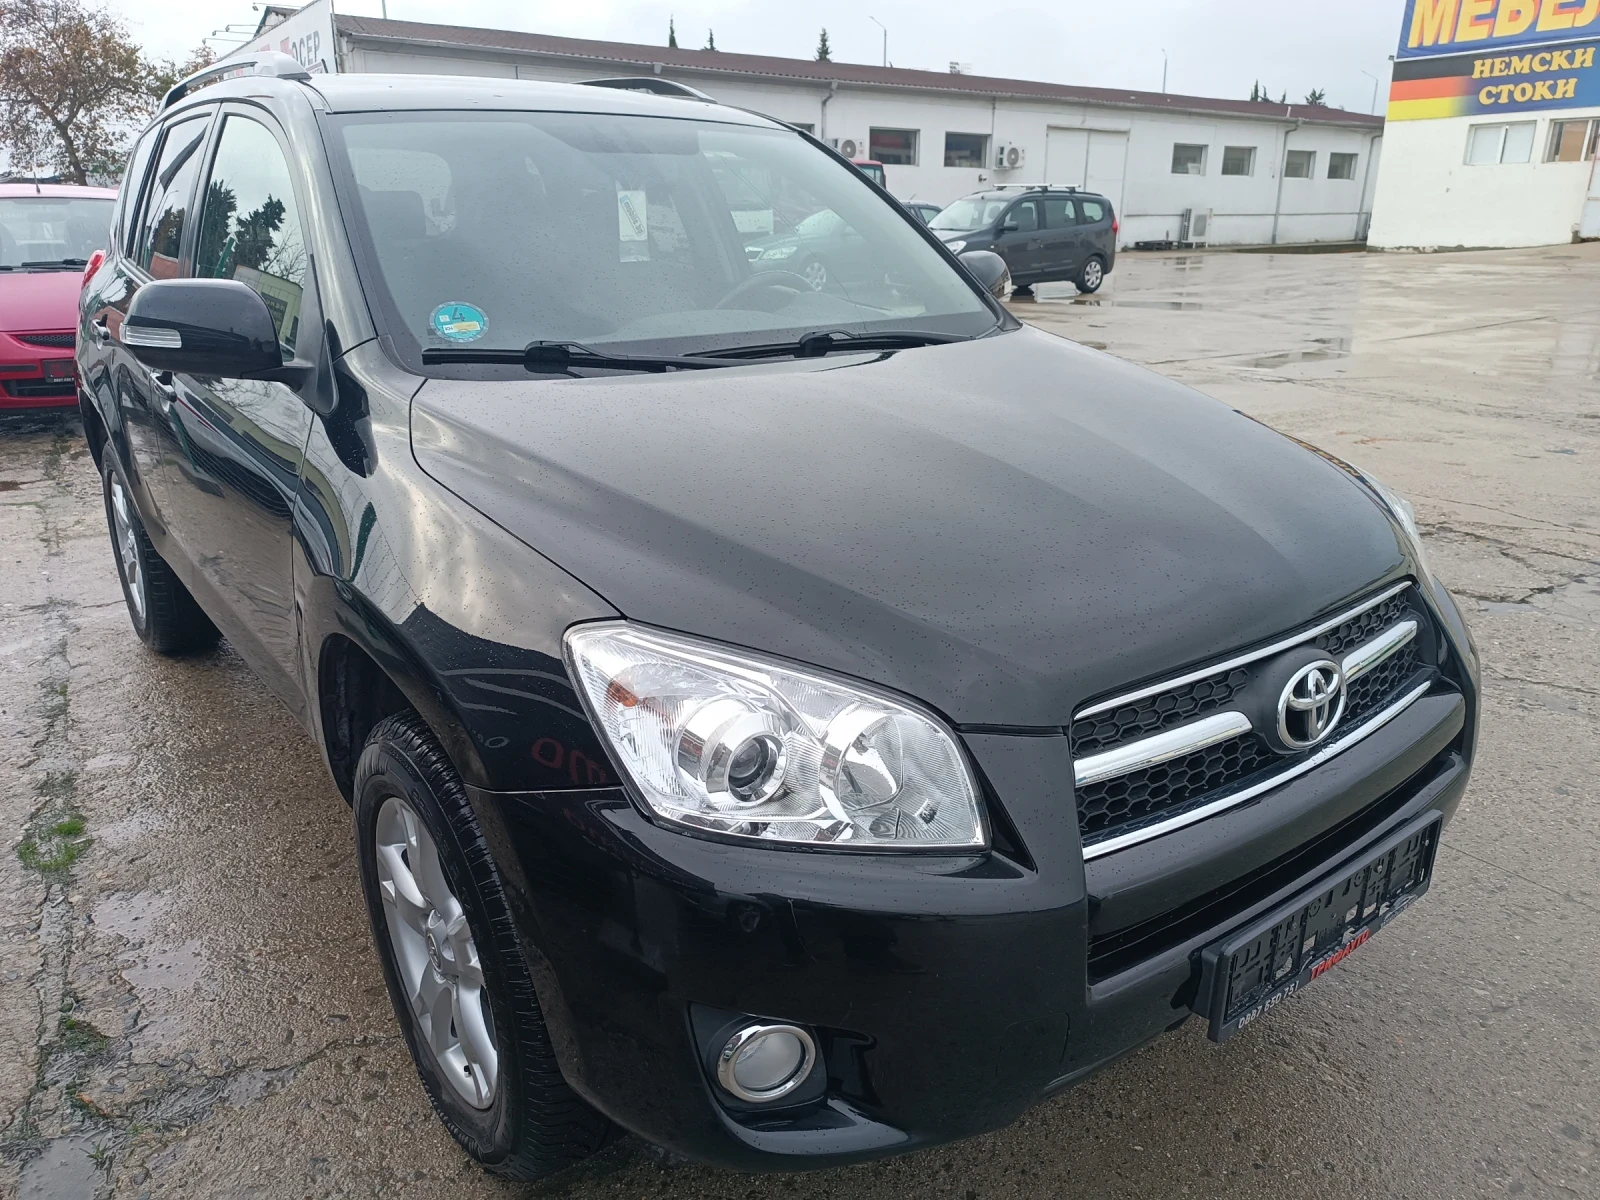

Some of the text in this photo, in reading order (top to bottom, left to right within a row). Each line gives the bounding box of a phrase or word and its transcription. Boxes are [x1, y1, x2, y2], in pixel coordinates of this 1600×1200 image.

[1471, 47, 1596, 79] НЕМСКИ
[1478, 78, 1578, 105] СТОКИ
[452, 306, 466, 322] 4
[1238, 980, 1299, 1029] 0887 650 751
